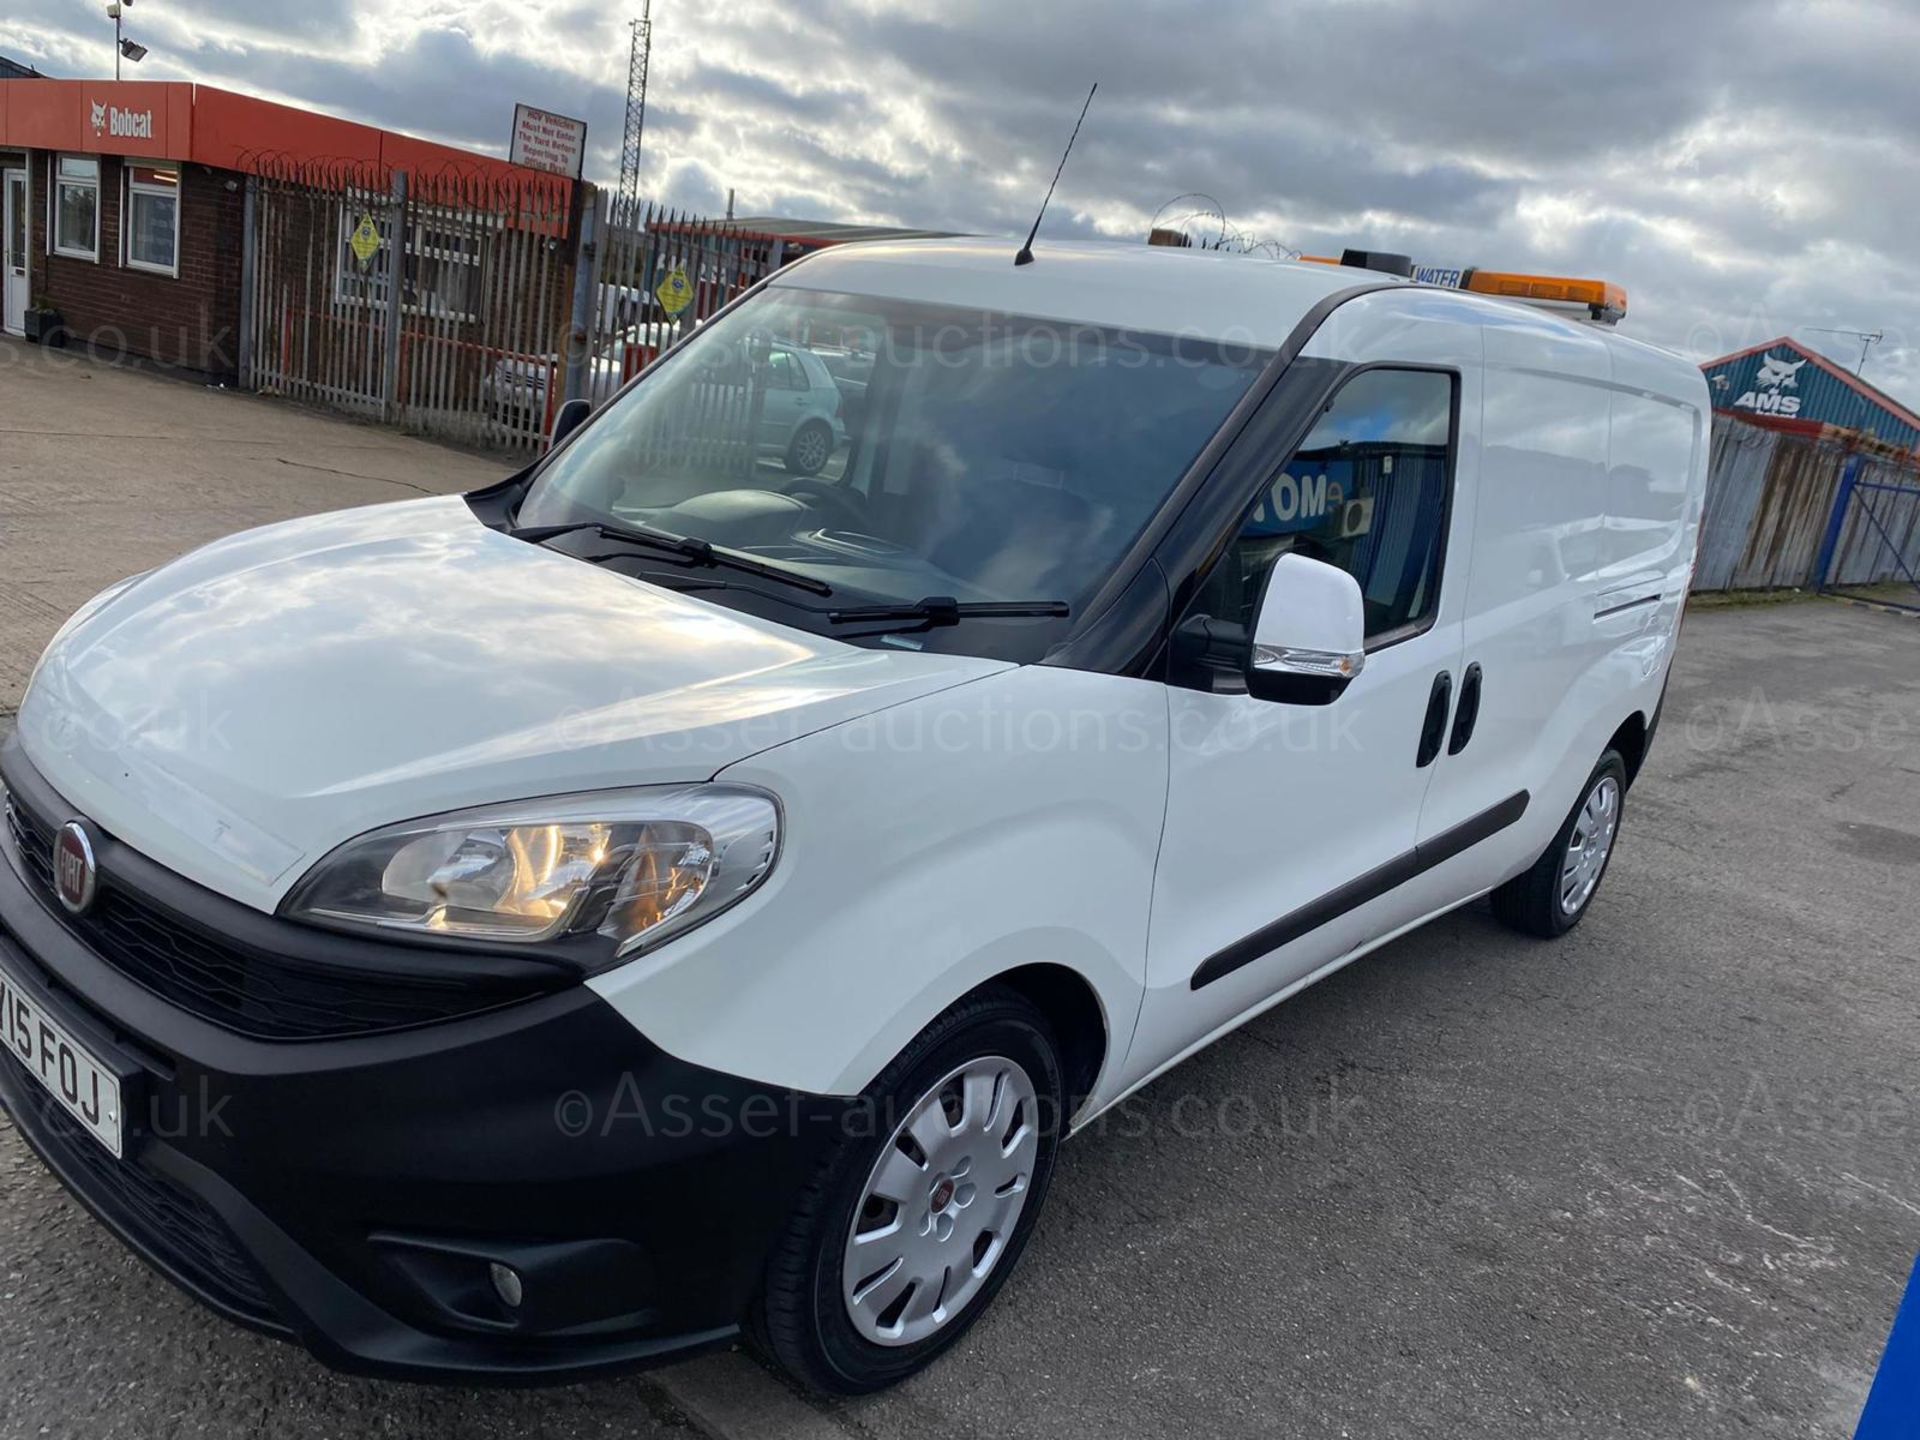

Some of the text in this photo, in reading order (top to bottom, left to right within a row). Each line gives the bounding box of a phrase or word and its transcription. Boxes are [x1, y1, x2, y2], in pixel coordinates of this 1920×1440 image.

[110, 106, 152, 138] Bobcat
[1416, 267, 1460, 288] WATER
[1734, 391, 1801, 413] AMS
[60, 846, 83, 894] FIAT
[39, 1021, 100, 1126] FOJ
